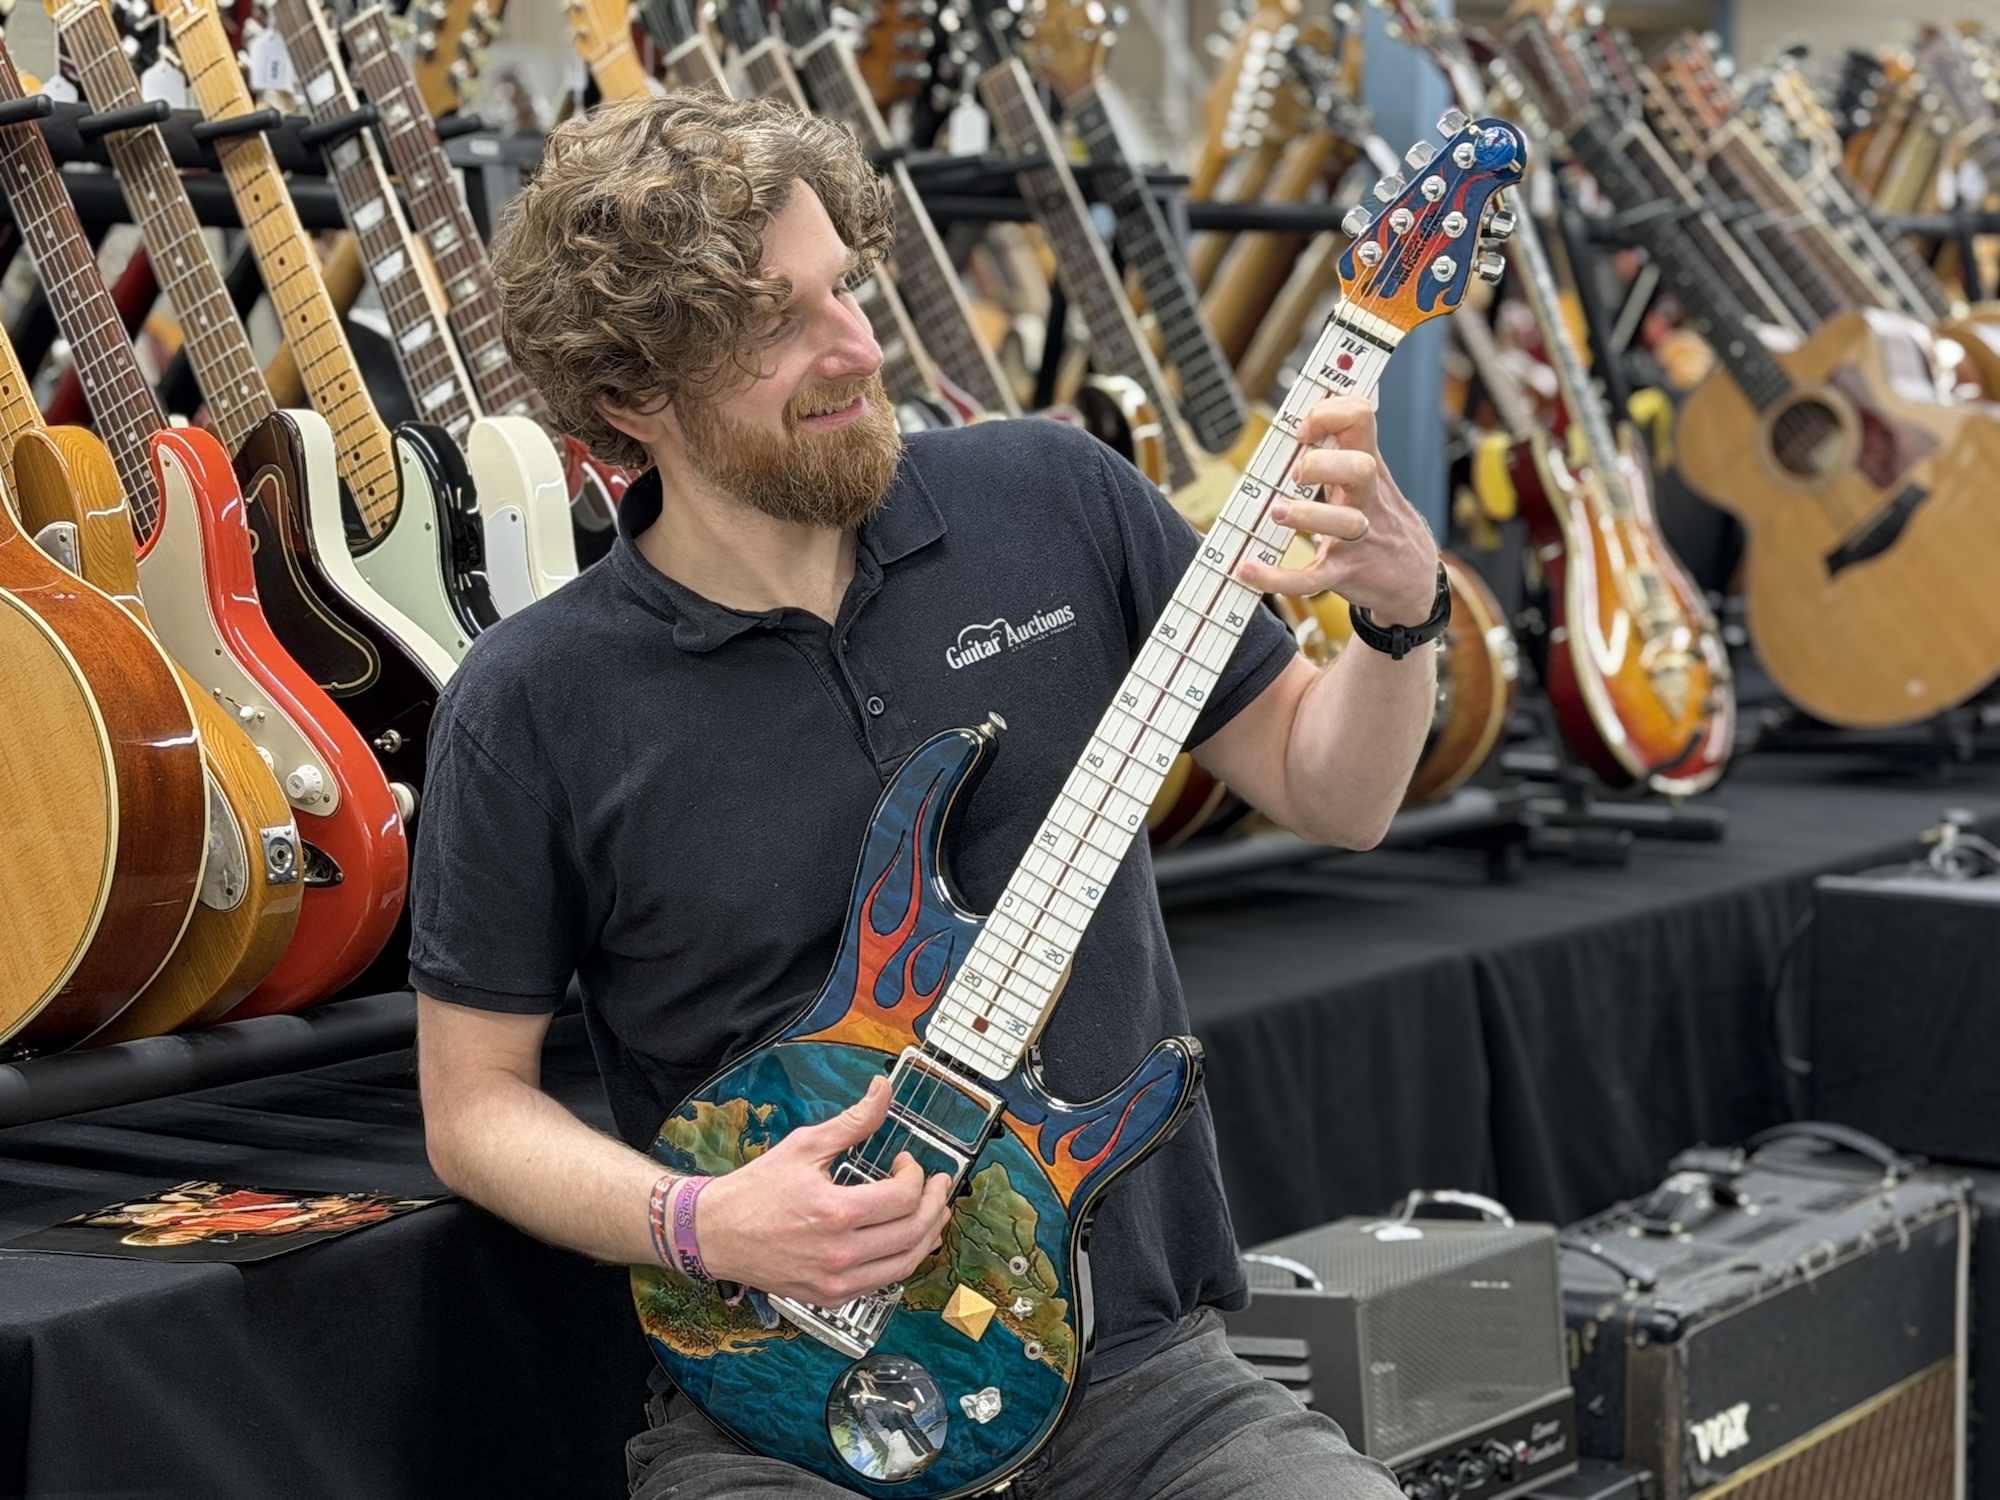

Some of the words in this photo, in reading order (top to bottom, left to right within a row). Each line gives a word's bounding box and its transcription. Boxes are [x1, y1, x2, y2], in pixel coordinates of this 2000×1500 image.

[1320, 364, 1357, 388] TEMP
[1257, 550, 1278, 566] 40
[1225, 611, 1245, 628] 30
[945, 636, 1002, 670] Guitar
[1004, 604, 1076, 648] Auctions
[1185, 685, 1205, 702] 20
[1086, 752, 1105, 769] 40
[1155, 753, 1170, 768] 10
[1127, 814, 1139, 826] 0
[1080, 885, 1100, 901] -10
[1042, 949, 1065, 966] -20
[1005, 1018, 1028, 1036] -30
[1690, 1401, 1750, 1464] VOX
